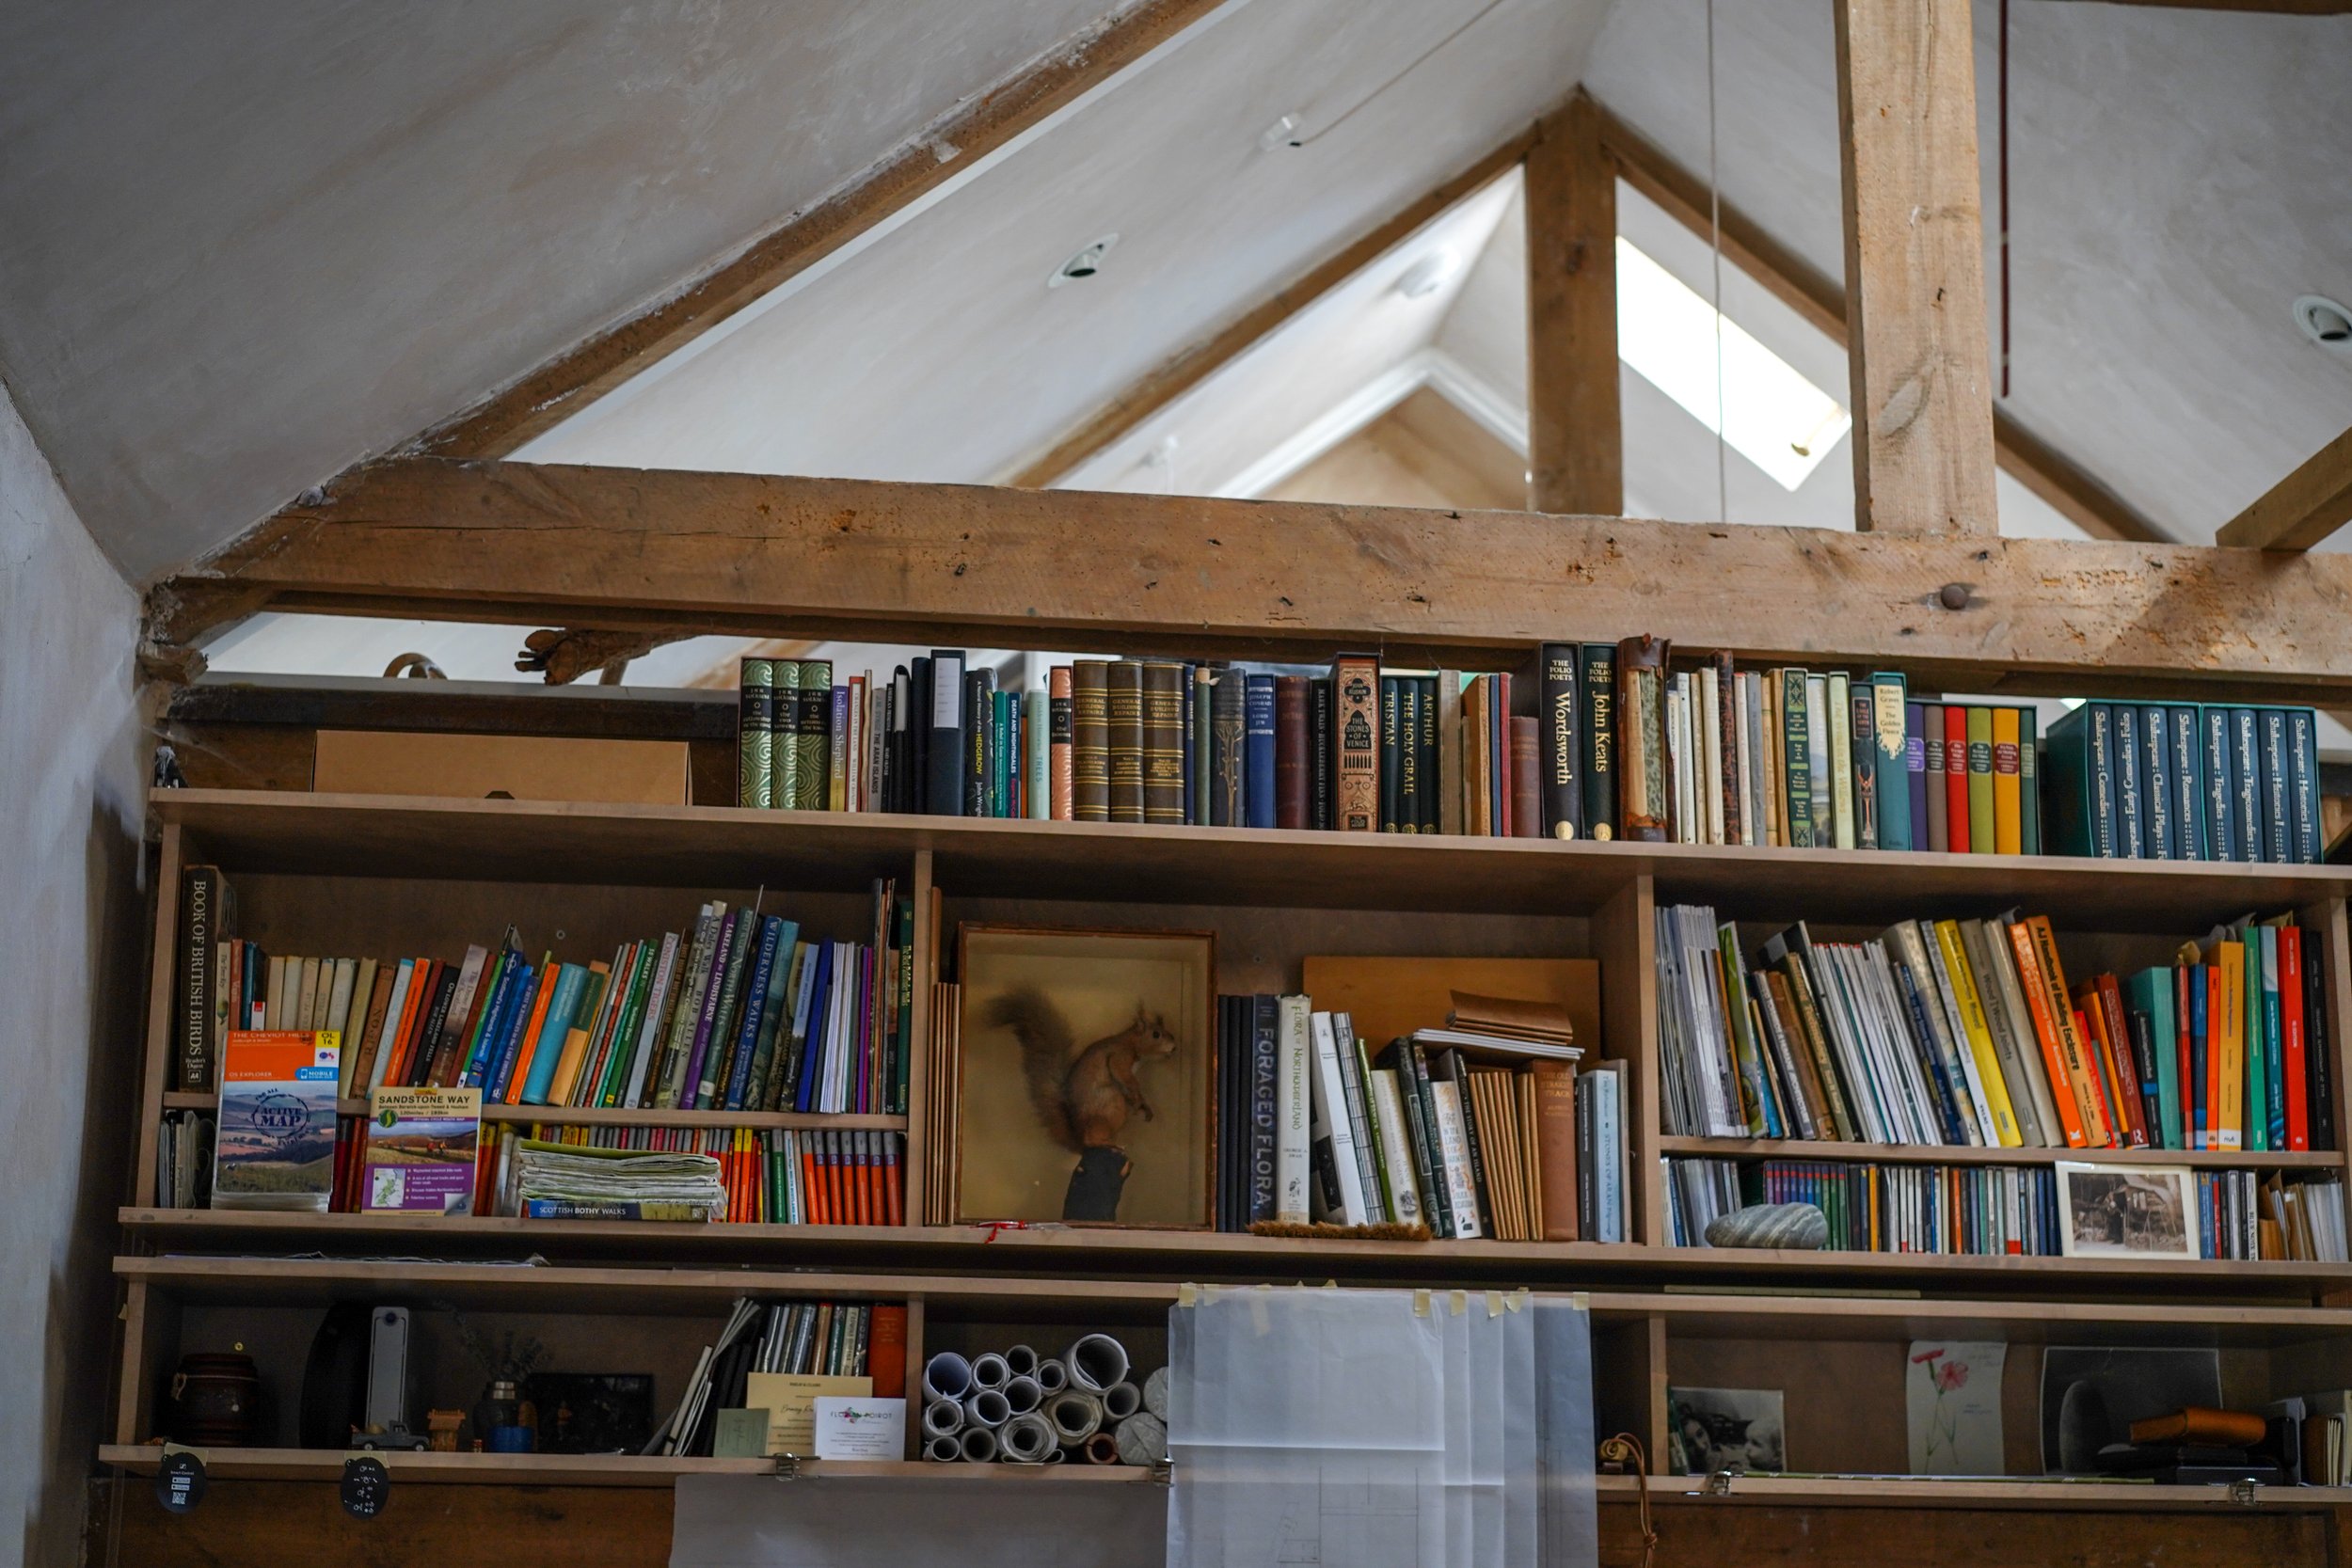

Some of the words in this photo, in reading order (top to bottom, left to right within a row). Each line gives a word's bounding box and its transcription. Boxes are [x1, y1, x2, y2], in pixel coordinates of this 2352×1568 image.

[836, 691, 845, 731] Isolation
[1385, 691, 1395, 746] TRISTAN
[1404, 692, 1414, 719] THE
[1423, 694, 1434, 746] ARTHUR
[1592, 690, 1610, 728] John
[1346, 724, 1370, 733] STONES
[1346, 739, 1369, 748] VENICE
[1404, 722, 1414, 754] HOLY
[1555, 691, 1573, 785] Wordsworth
[2093, 711, 2106, 767] Shakespeare
[2120, 713, 2130, 738] Folio
[2147, 713, 2161, 768] Shakespeare
[2177, 713, 2190, 769] Shakespeare
[2209, 714, 2222, 770] Shakespeare
[2239, 715, 2252, 771] Shakespeare
[833, 734, 845, 779] Shepherd
[1595, 732, 1611, 773] Keats
[2267, 716, 2280, 772] Shakespeare
[2294, 718, 2306, 774] Shakespeare
[871, 767, 880, 794] ISLANDS
[1035, 756, 1043, 783] TREES
[1403, 757, 1414, 795] GRAIL
[2122, 744, 2134, 789] Comedies
[2098, 772, 2110, 818] Comedies
[2123, 789, 2137, 815] Early
[2153, 773, 2166, 814] Classical
[2182, 775, 2193, 823] Romances
[2212, 776, 2226, 819] Tragedies
[2241, 776, 2257, 843] Tragicomedies
[2273, 777, 2284, 820] Histories
[2299, 779, 2311, 822] Histories
[2152, 815, 2166, 839] Plays
[2301, 823, 2312, 833] II
[193, 880, 206, 923] BOOK
[711, 914, 720, 923] A
[192, 924, 205, 945] OF
[705, 925, 718, 950] Dales
[717, 922, 733, 963] LAKELAND
[902, 945, 911, 954] The
[2036, 925, 2047, 939] AJ
[641, 956, 652, 979] WALKS
[655, 934, 675, 985] CONISTON
[699, 952, 712, 975] Walk
[725, 955, 743, 993] NORTH
[754, 920, 778, 995] WILDERNESS
[901, 955, 911, 966] Best
[2039, 938, 2058, 982] Handbook
[190, 948, 205, 1006] BRITISH
[494, 975, 511, 1005] Scotland's
[1948, 929, 1961, 953] Timber
[1955, 955, 1974, 1000] Construction
[1968, 1001, 1983, 1029] Manual
[2050, 981, 2060, 992] of
[438, 993, 452, 1014] LOWER
[647, 987, 662, 1020] TIGERS
[690, 989, 702, 1014] BOB
[703, 971, 722, 1022] LINDISFARNE
[717, 992, 734, 1026] WALES
[900, 991, 910, 1006] Walks
[1787, 952, 1810, 1001] Building
[1803, 1004, 1829, 1064] Technology
[2052, 992, 2069, 1027] Building
[189, 1010, 203, 1056] BIRDS
[364, 1007, 382, 1056] RIPON
[427, 1013, 446, 1045] LAKELAND
[484, 1003, 501, 1032] Highlands
[623, 1027, 632, 1041] Dales
[627, 1005, 638, 1027] Yorkshire
[745, 998, 761, 1039] WALKS
[1291, 1006, 1303, 1037] FLORA
[1982, 973, 1996, 1001] Wood
[1991, 1007, 2005, 1033] Wood
[1998, 1033, 2013, 1060] Joints
[422, 1044, 436, 1063] FELLS
[476, 1037, 489, 1058] Islands
[680, 1020, 695, 1059] ALLEN
[2062, 1027, 2081, 1071] Enclosure
[2107, 988, 2125, 1049] CONSTRUCTION
[2117, 1049, 2134, 1097] CONTRACTS
[1257, 1027, 1274, 1128] FORAGED
[1292, 1047, 1303, 1131] NORTHUMBERLAND
[1545, 1089, 1570, 1098] TRACK
[379, 1095, 444, 1104] SANDSTONE
[448, 1095, 470, 1104] WAY
[1462, 1100, 1471, 1114] THE
[1786, 1069, 1811, 1125] ARCHITECTURE
[260, 1115, 302, 1127] MAP
[1465, 1114, 1475, 1135] STORY
[1468, 1136, 1477, 1145] OF
[1470, 1146, 1479, 1158] AN
[1603, 1133, 1611, 1166] STONES
[1255, 1134, 1273, 1205] FLORA
[1472, 1158, 1483, 1182] ISLAND
[1604, 1168, 1611, 1181] OF
[539, 1206, 574, 1214] SCOTTISH
[574, 1207, 599, 1215] BOTHY
[601, 1207, 627, 1216] WALKS
